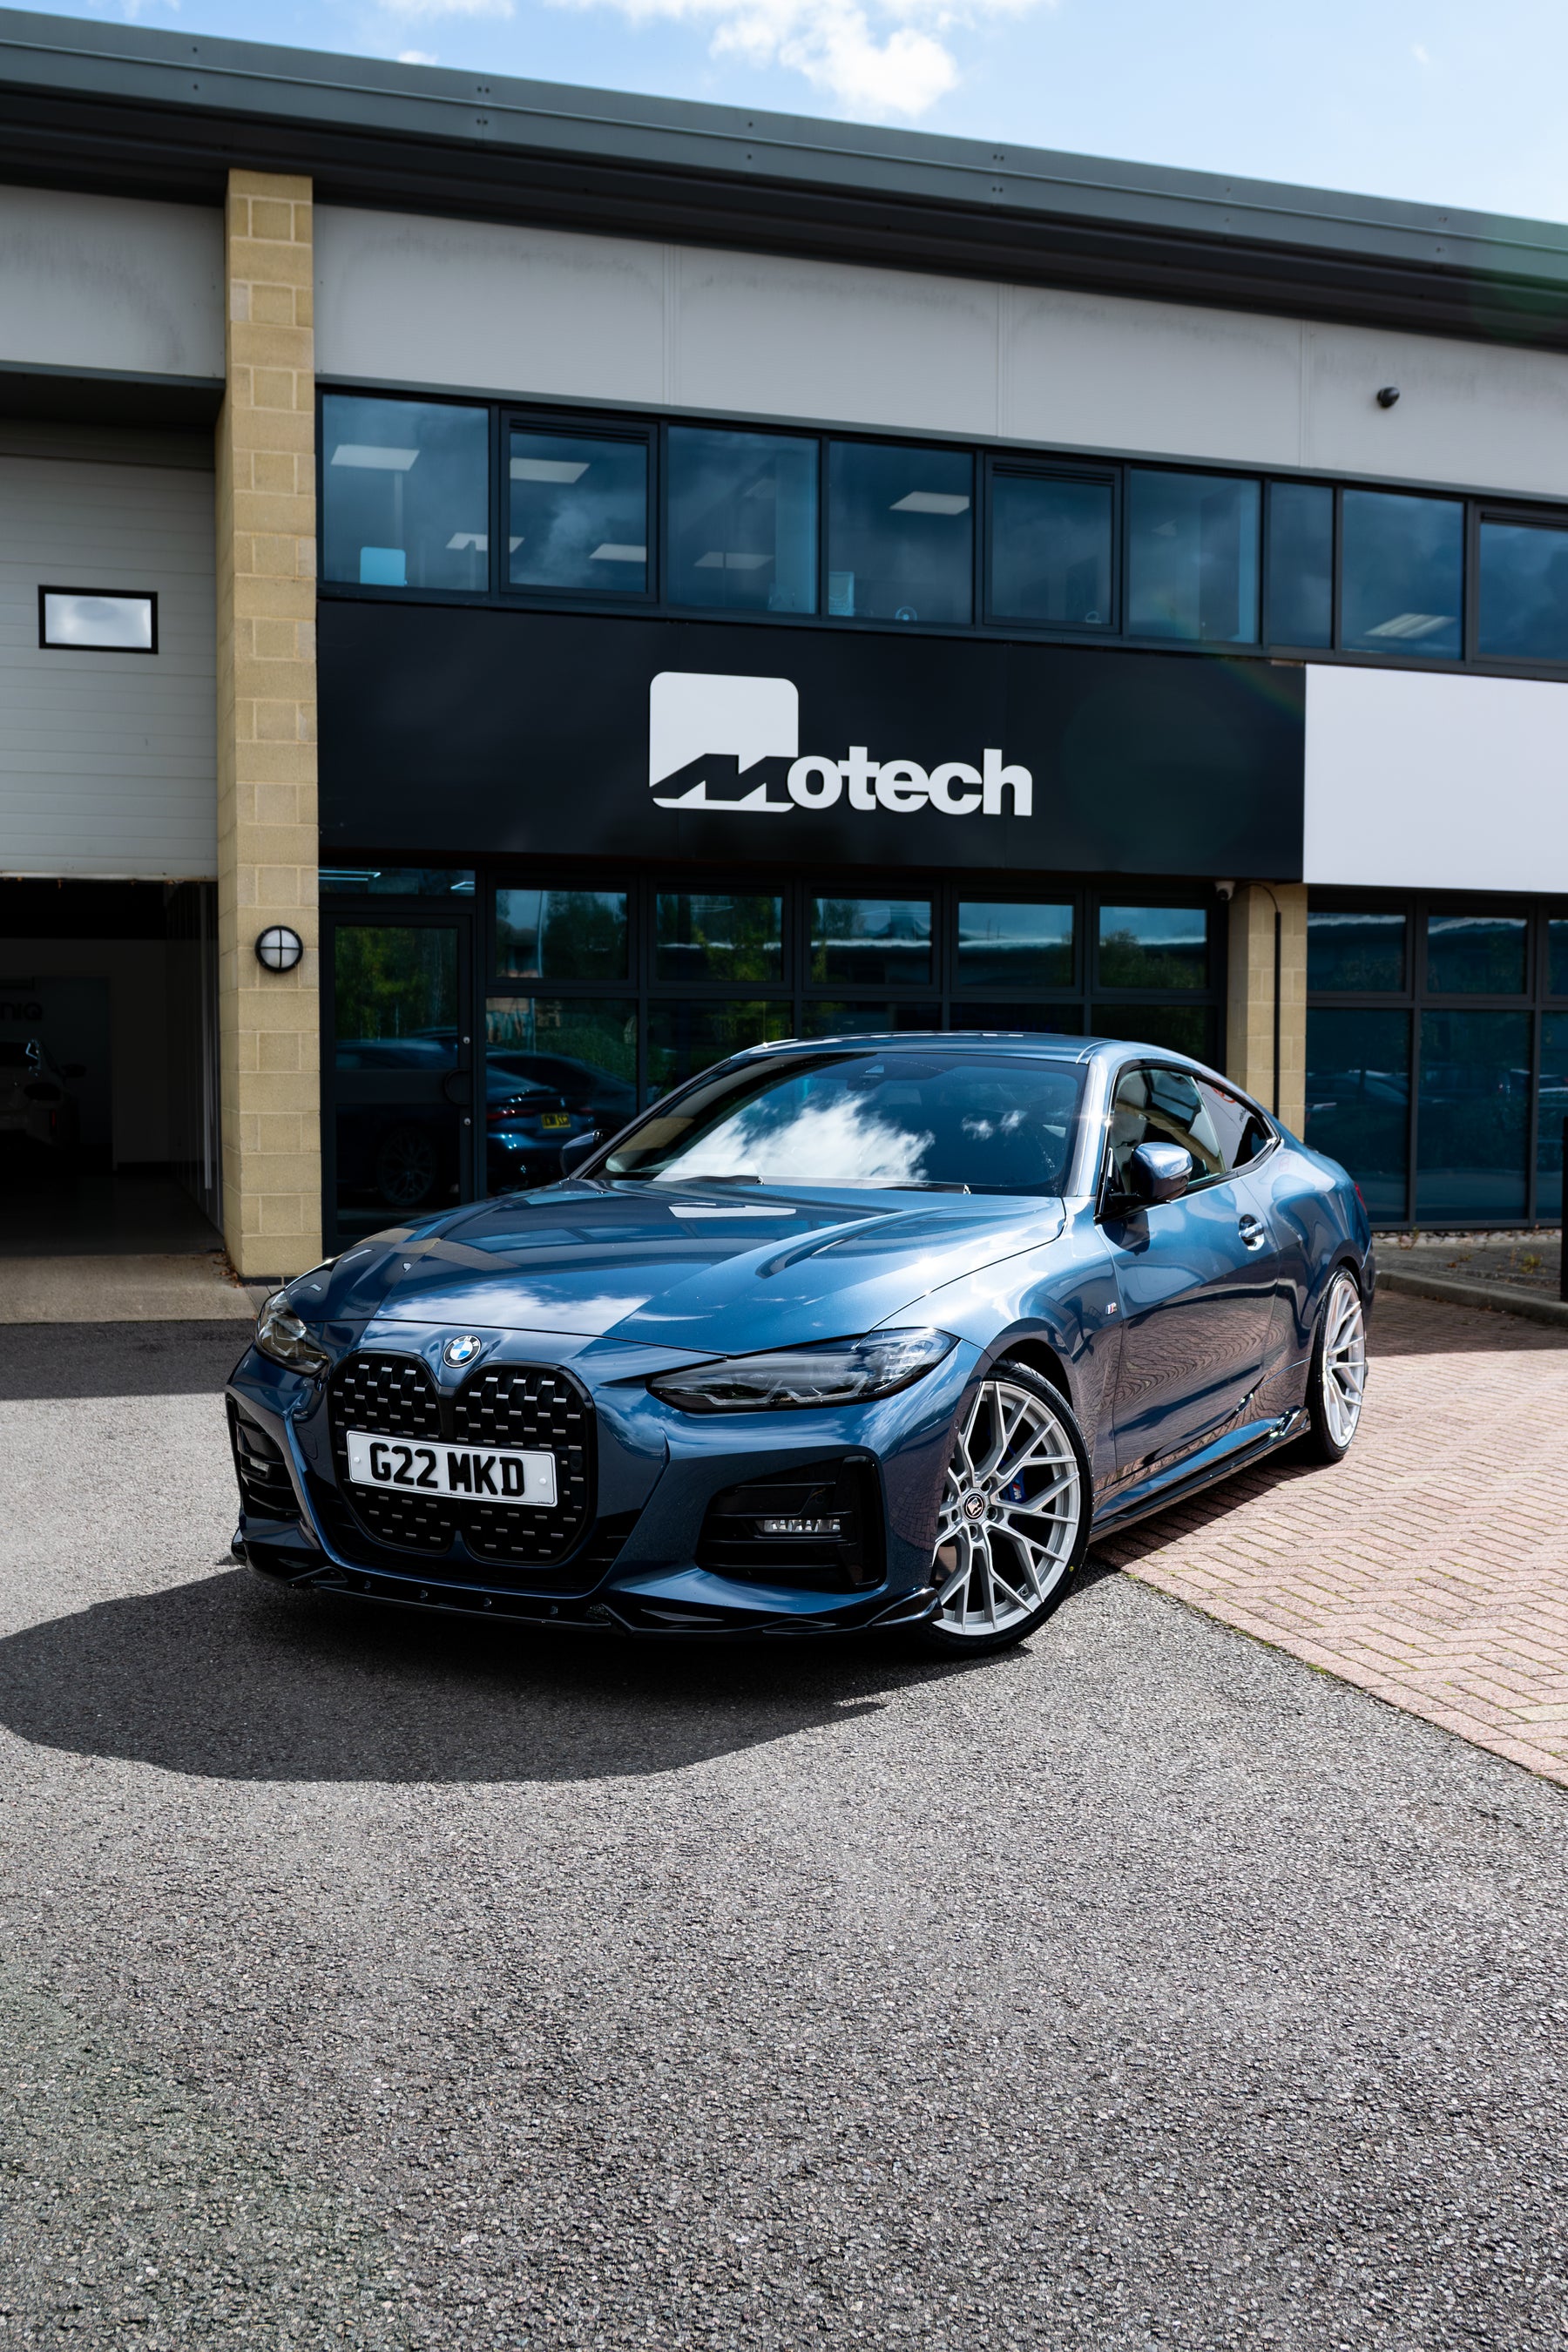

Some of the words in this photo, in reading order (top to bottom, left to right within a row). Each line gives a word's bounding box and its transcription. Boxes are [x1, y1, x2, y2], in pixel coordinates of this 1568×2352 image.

[649, 672, 1033, 817] Motech
[369, 1442, 438, 1488] G22
[447, 1452, 524, 1497] MKD
